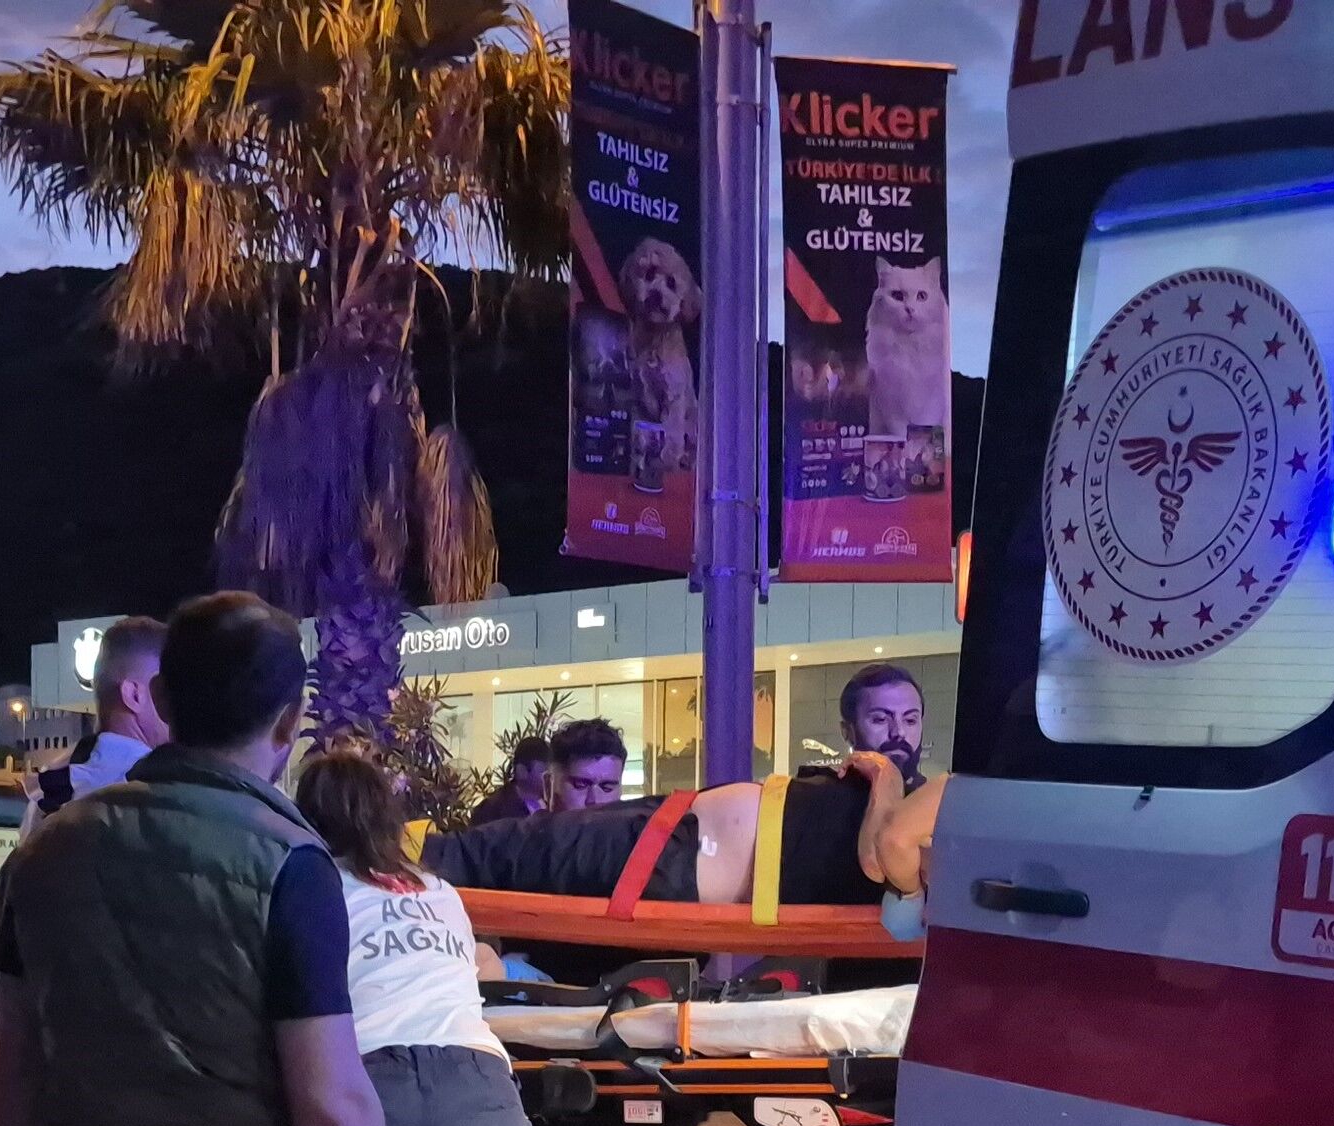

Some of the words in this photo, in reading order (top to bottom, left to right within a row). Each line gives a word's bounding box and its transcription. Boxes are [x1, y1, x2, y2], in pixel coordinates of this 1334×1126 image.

[780, 91, 939, 140] Klicker
[596, 131, 669, 173] TAHILSIZ
[626, 165, 640, 188] &
[816, 183, 913, 207] TAHILSIZ
[856, 208, 874, 228] &
[805, 226, 925, 253] GLÜTENSİZ
[1210, 349, 1265, 421] SAĞLIK
[1205, 427, 1268, 572] BAKANLIĞI
[398, 626, 462, 655] rusan
[465, 617, 510, 649] Oto
